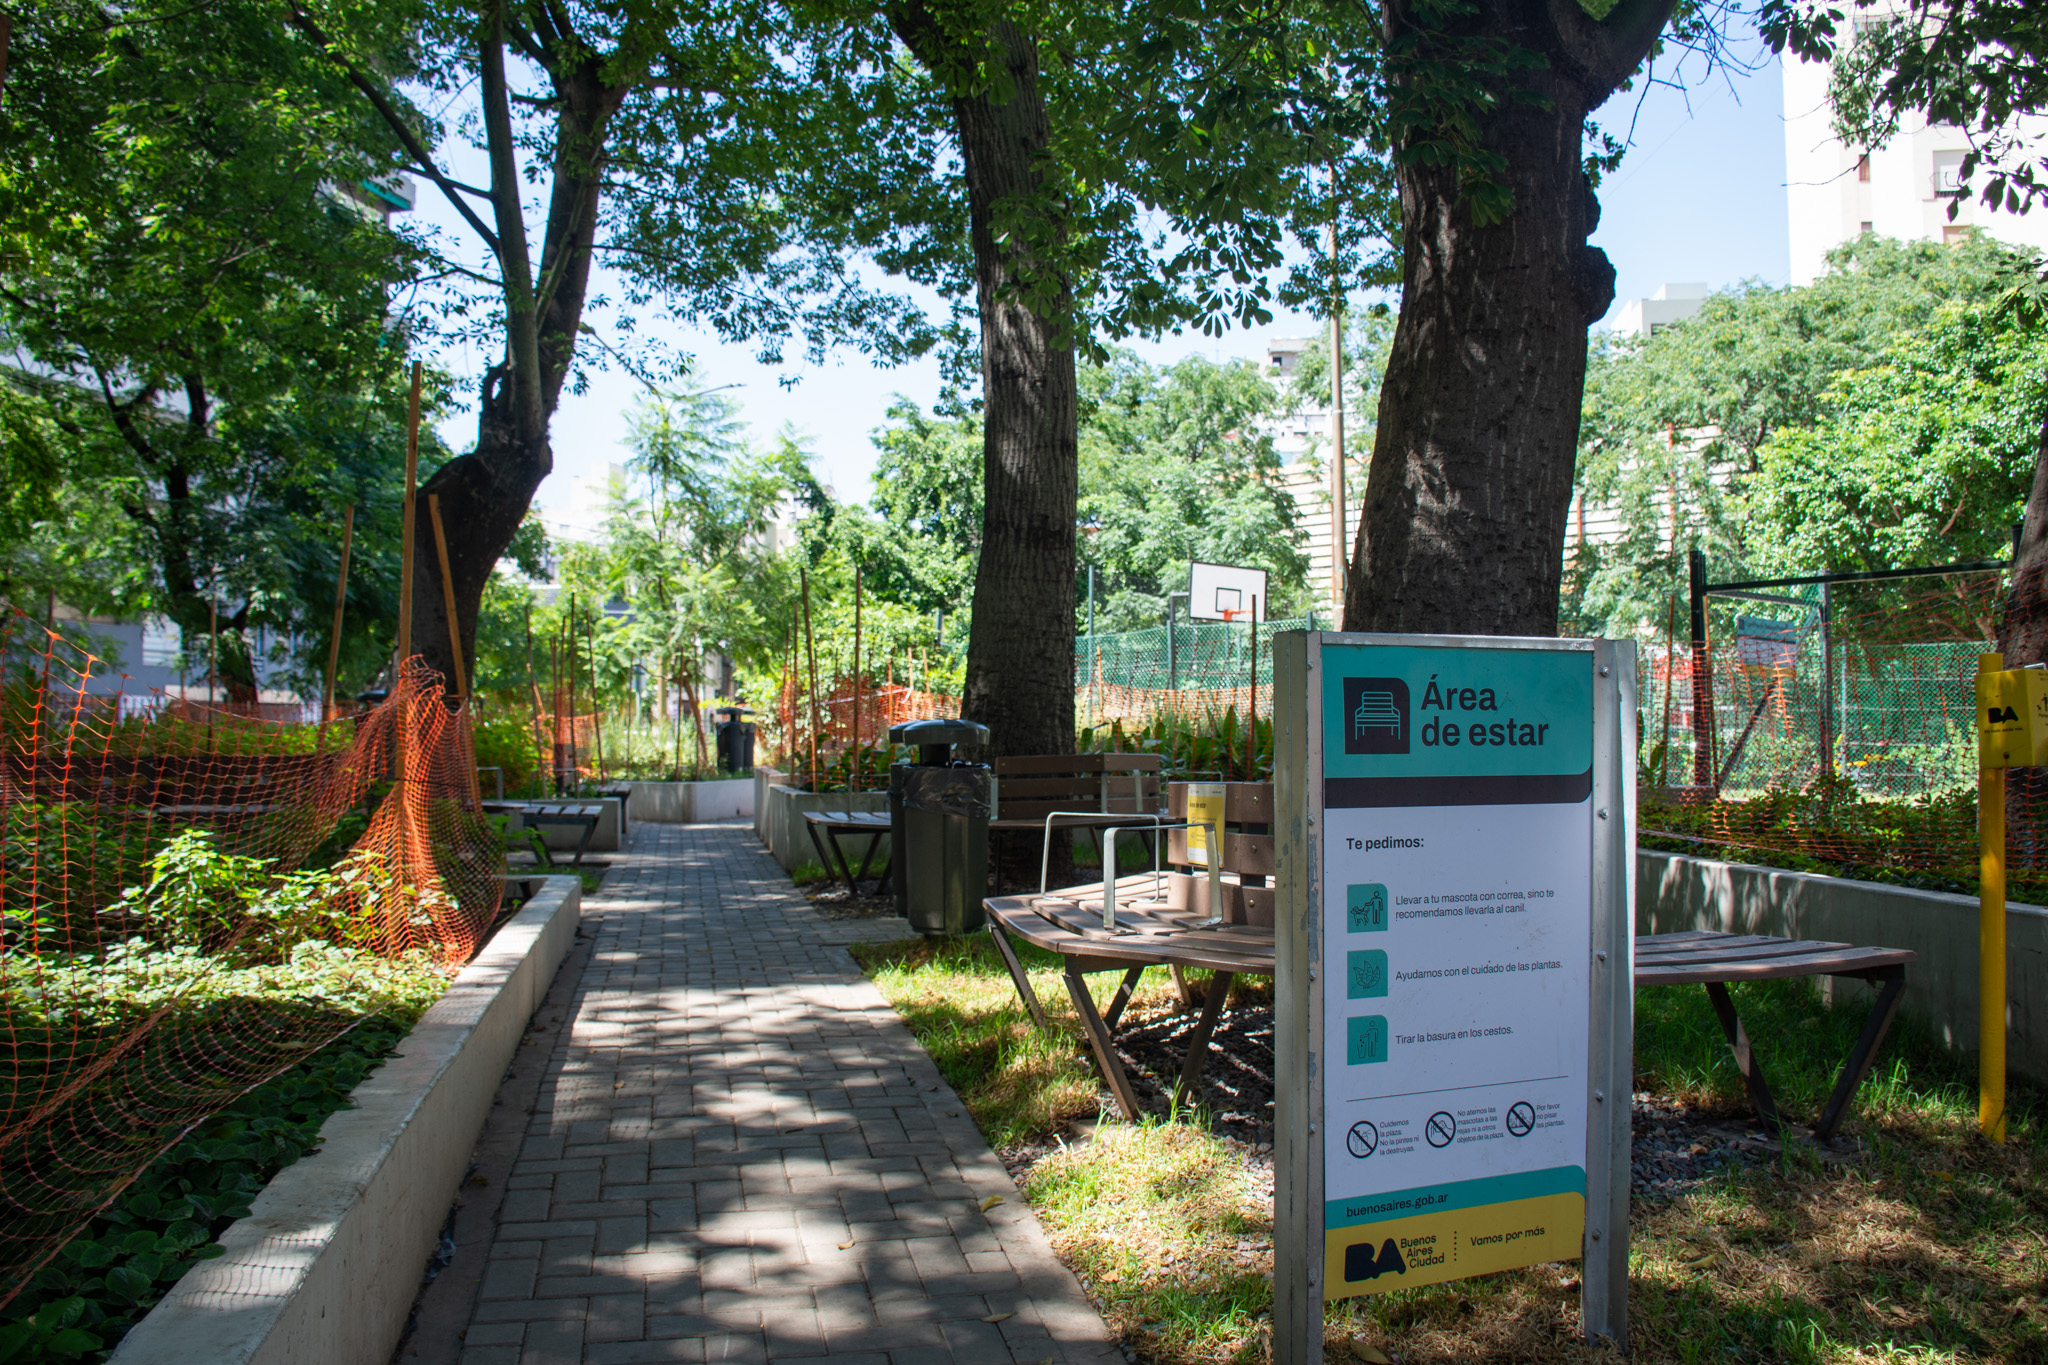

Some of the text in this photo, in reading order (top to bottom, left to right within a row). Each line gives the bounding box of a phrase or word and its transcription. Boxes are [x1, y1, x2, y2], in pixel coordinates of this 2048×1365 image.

[1421, 674, 1497, 711] Área
[1988, 706, 2018, 723] BA
[1421, 716, 1548, 746] de estar
[1346, 836, 1424, 852] Te pedimos:
[1395, 896, 1422, 905] Llevar
[1441, 893, 1478, 903] mascota
[1480, 893, 1495, 901] con
[1497, 891, 1526, 901] correa,
[1527, 889, 1545, 898] sino
[1546, 889, 1554, 897] te
[1395, 903, 1526, 919] recomendamos llevarla al canil.
[1396, 960, 1562, 981] Ayudarnos con el cuidado de las plantas.
[1396, 1025, 1513, 1044] Tirar la basura en los cestos.
[1380, 1120, 1409, 1128] Cuidemos
[1386, 1129, 1402, 1138] plaza.
[1457, 1135, 1476, 1144] objetos
[1386, 1146, 1415, 1155] destruyas.
[1346, 1192, 1448, 1217] buenosaires.gob.ar
[1401, 1235, 1436, 1248] Buenos
[1470, 1226, 1545, 1246] Vamos por más
[1406, 1246, 1433, 1258] Aires
[1345, 1238, 1406, 1283] BA
[1409, 1253, 1444, 1268] Ciudad
